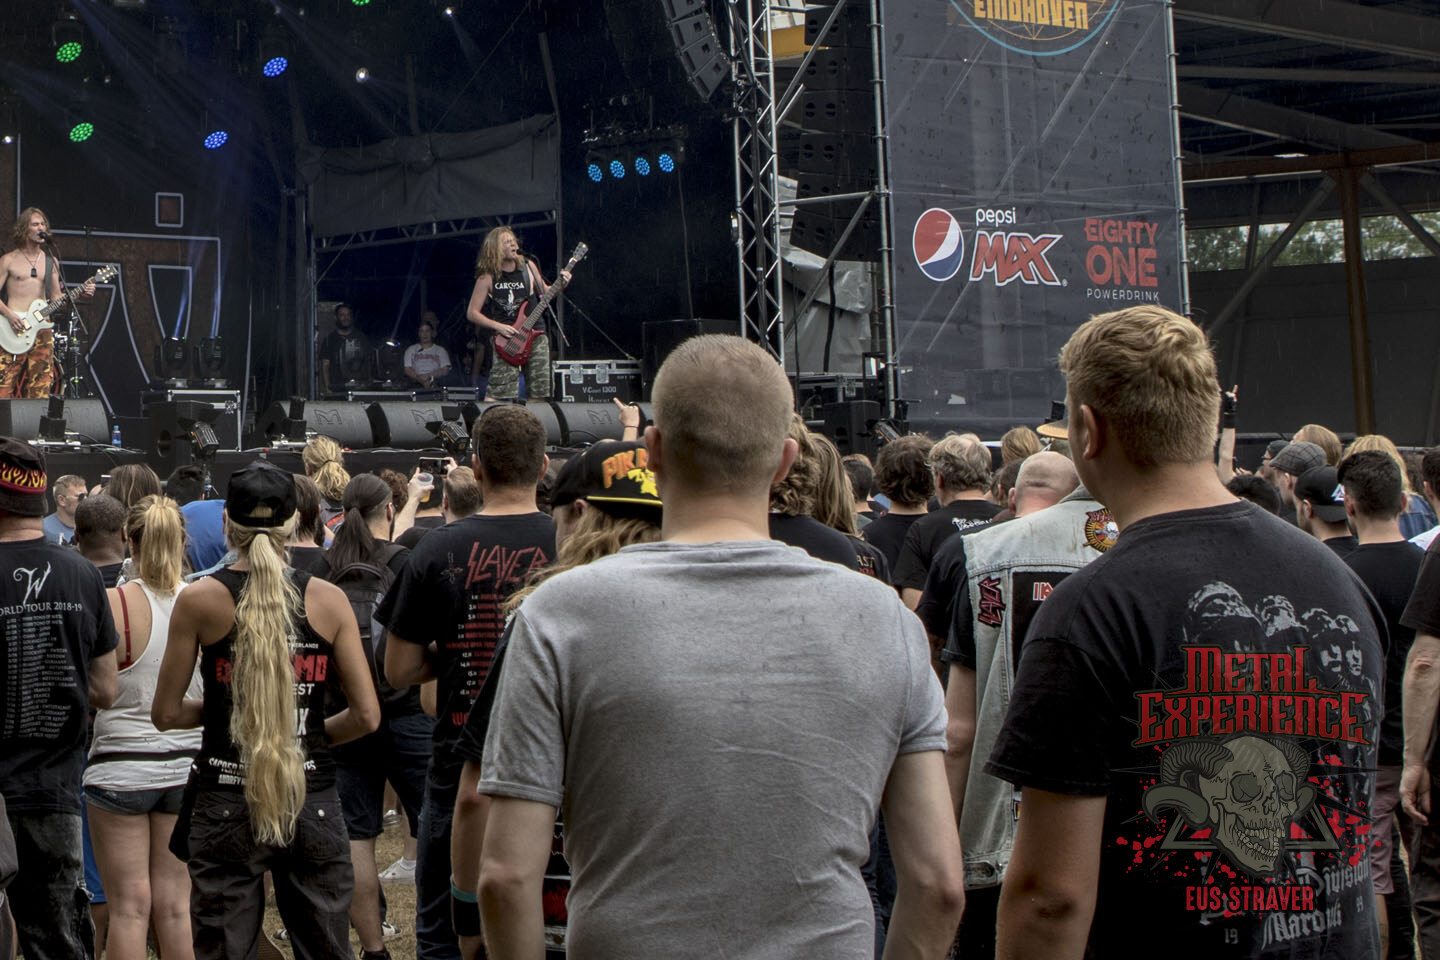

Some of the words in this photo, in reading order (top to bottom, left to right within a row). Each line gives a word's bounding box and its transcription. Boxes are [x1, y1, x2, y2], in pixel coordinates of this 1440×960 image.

[975, 207, 1016, 227] pepsi
[1084, 217, 1159, 246] EIGHTY
[969, 230, 1063, 287] MAX
[1085, 244, 1158, 287] ONE
[1086, 288, 1160, 302] POWERDRINK
[464, 541, 549, 590] SLAYER
[26, 602, 52, 613] TOUR
[54, 601, 82, 612] 2018-19
